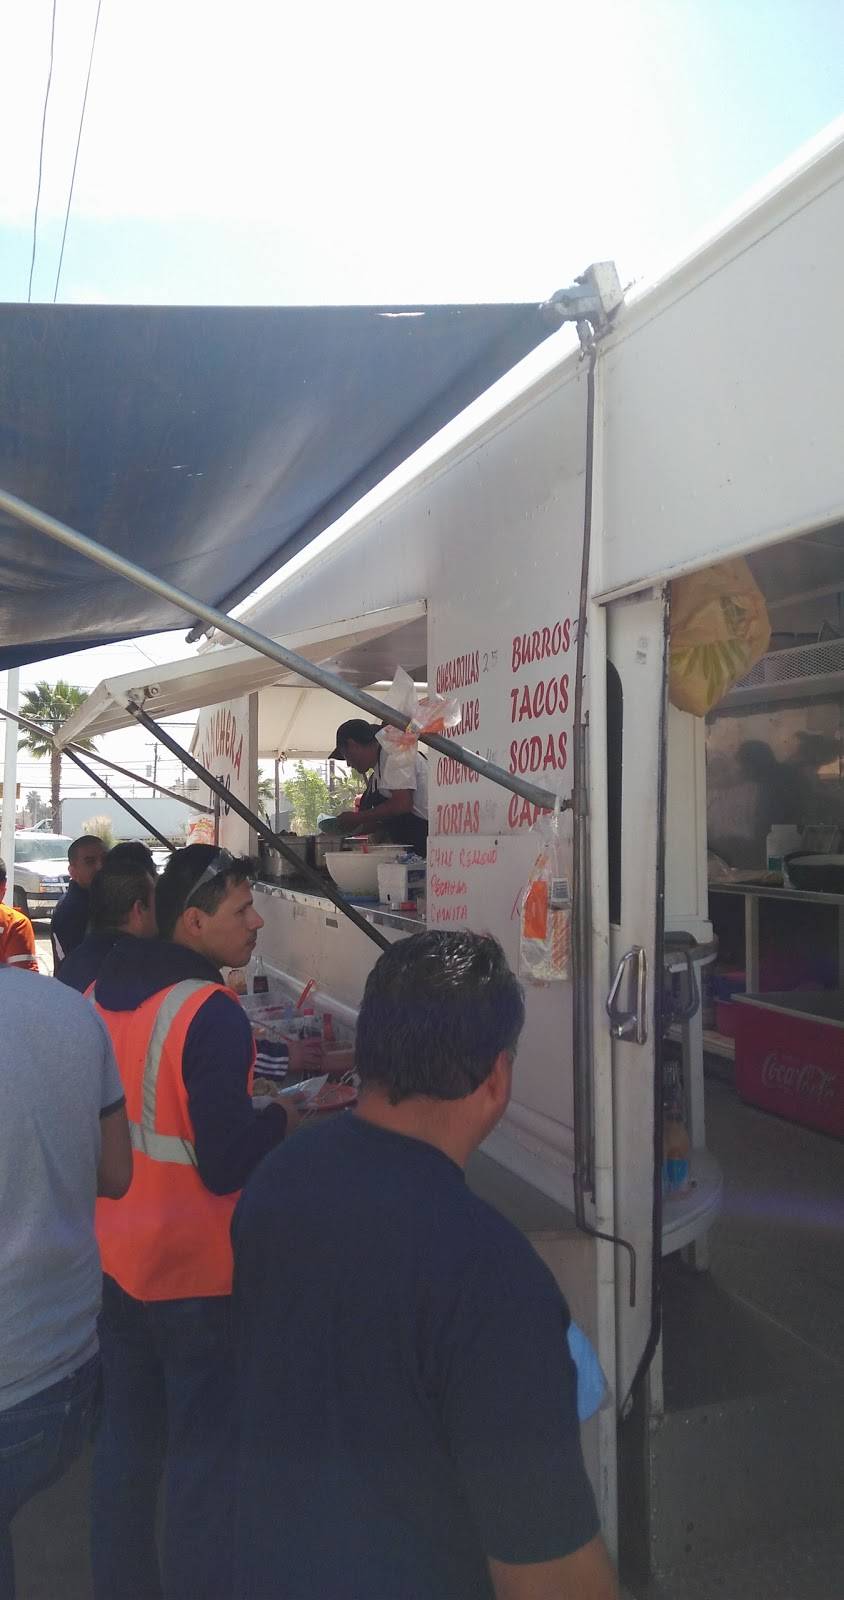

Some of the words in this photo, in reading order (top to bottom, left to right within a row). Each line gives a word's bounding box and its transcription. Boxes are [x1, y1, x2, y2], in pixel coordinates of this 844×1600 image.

[511, 618, 571, 673] BURROS
[436, 650, 480, 694] QUESADILLAS
[511, 674, 570, 724] TACOS
[509, 731, 568, 775] SODAS
[435, 800, 480, 836] TORTAS
